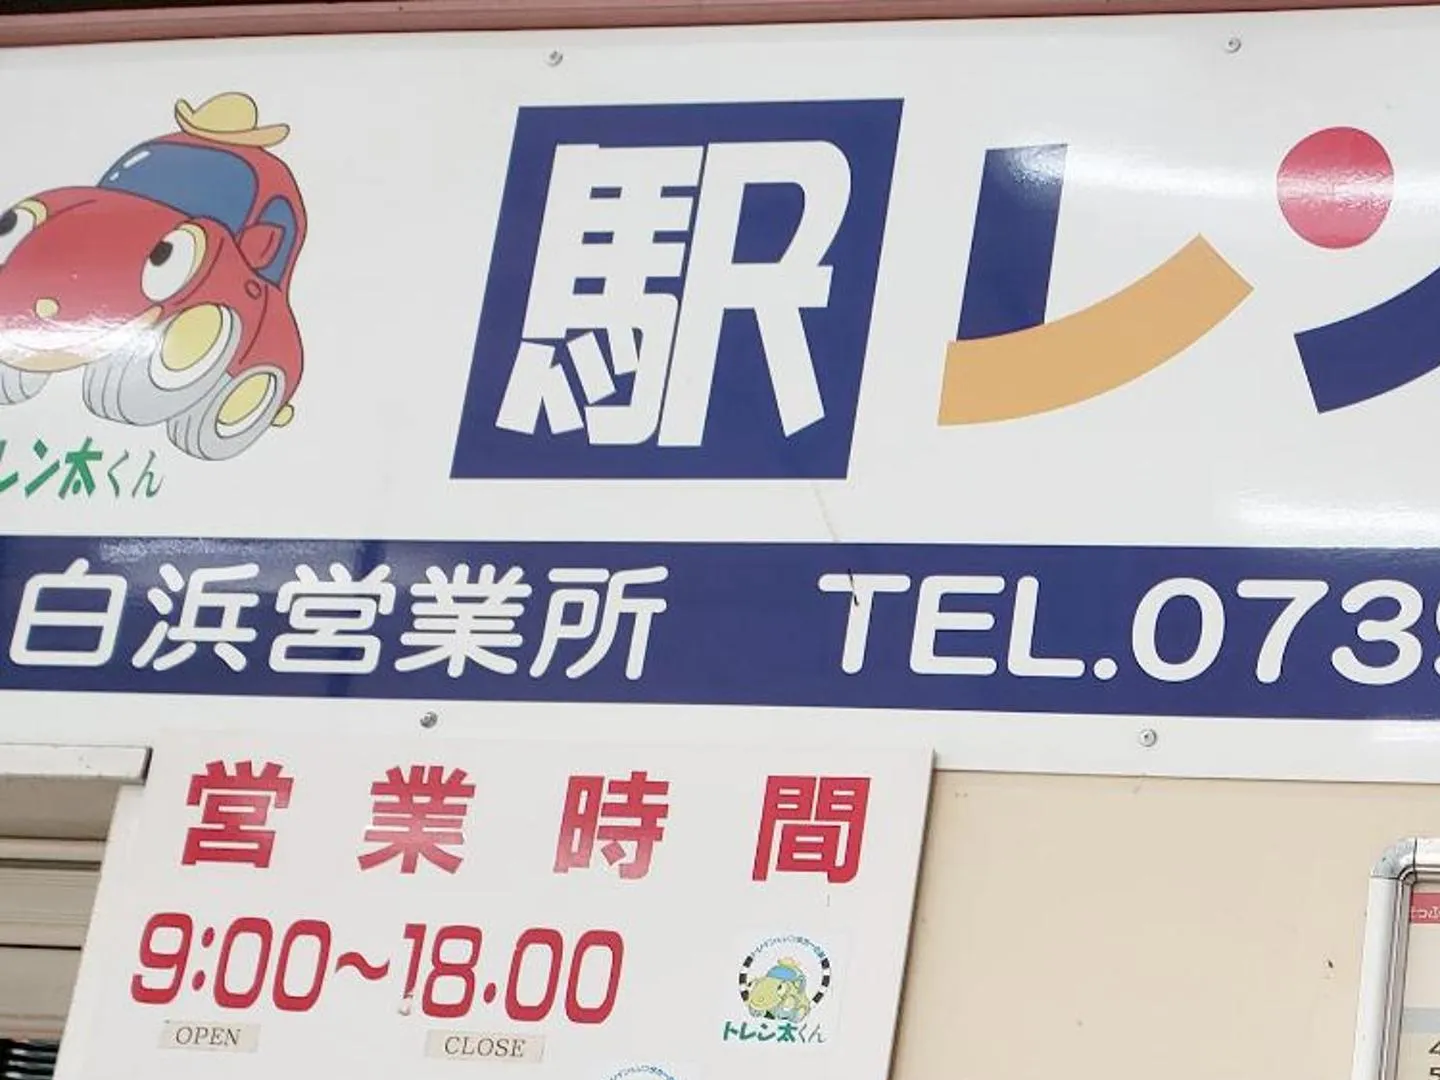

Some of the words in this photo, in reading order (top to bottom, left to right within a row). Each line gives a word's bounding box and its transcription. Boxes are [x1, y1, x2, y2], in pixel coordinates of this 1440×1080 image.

[10, 558, 668, 681] 白浜営業所
[182, 760, 872, 884] 営業時間
[176, 1027, 242, 1048] OPEN
[722, 1020, 827, 1044] トレン太くん
[444, 1036, 526, 1060] CLOSE
